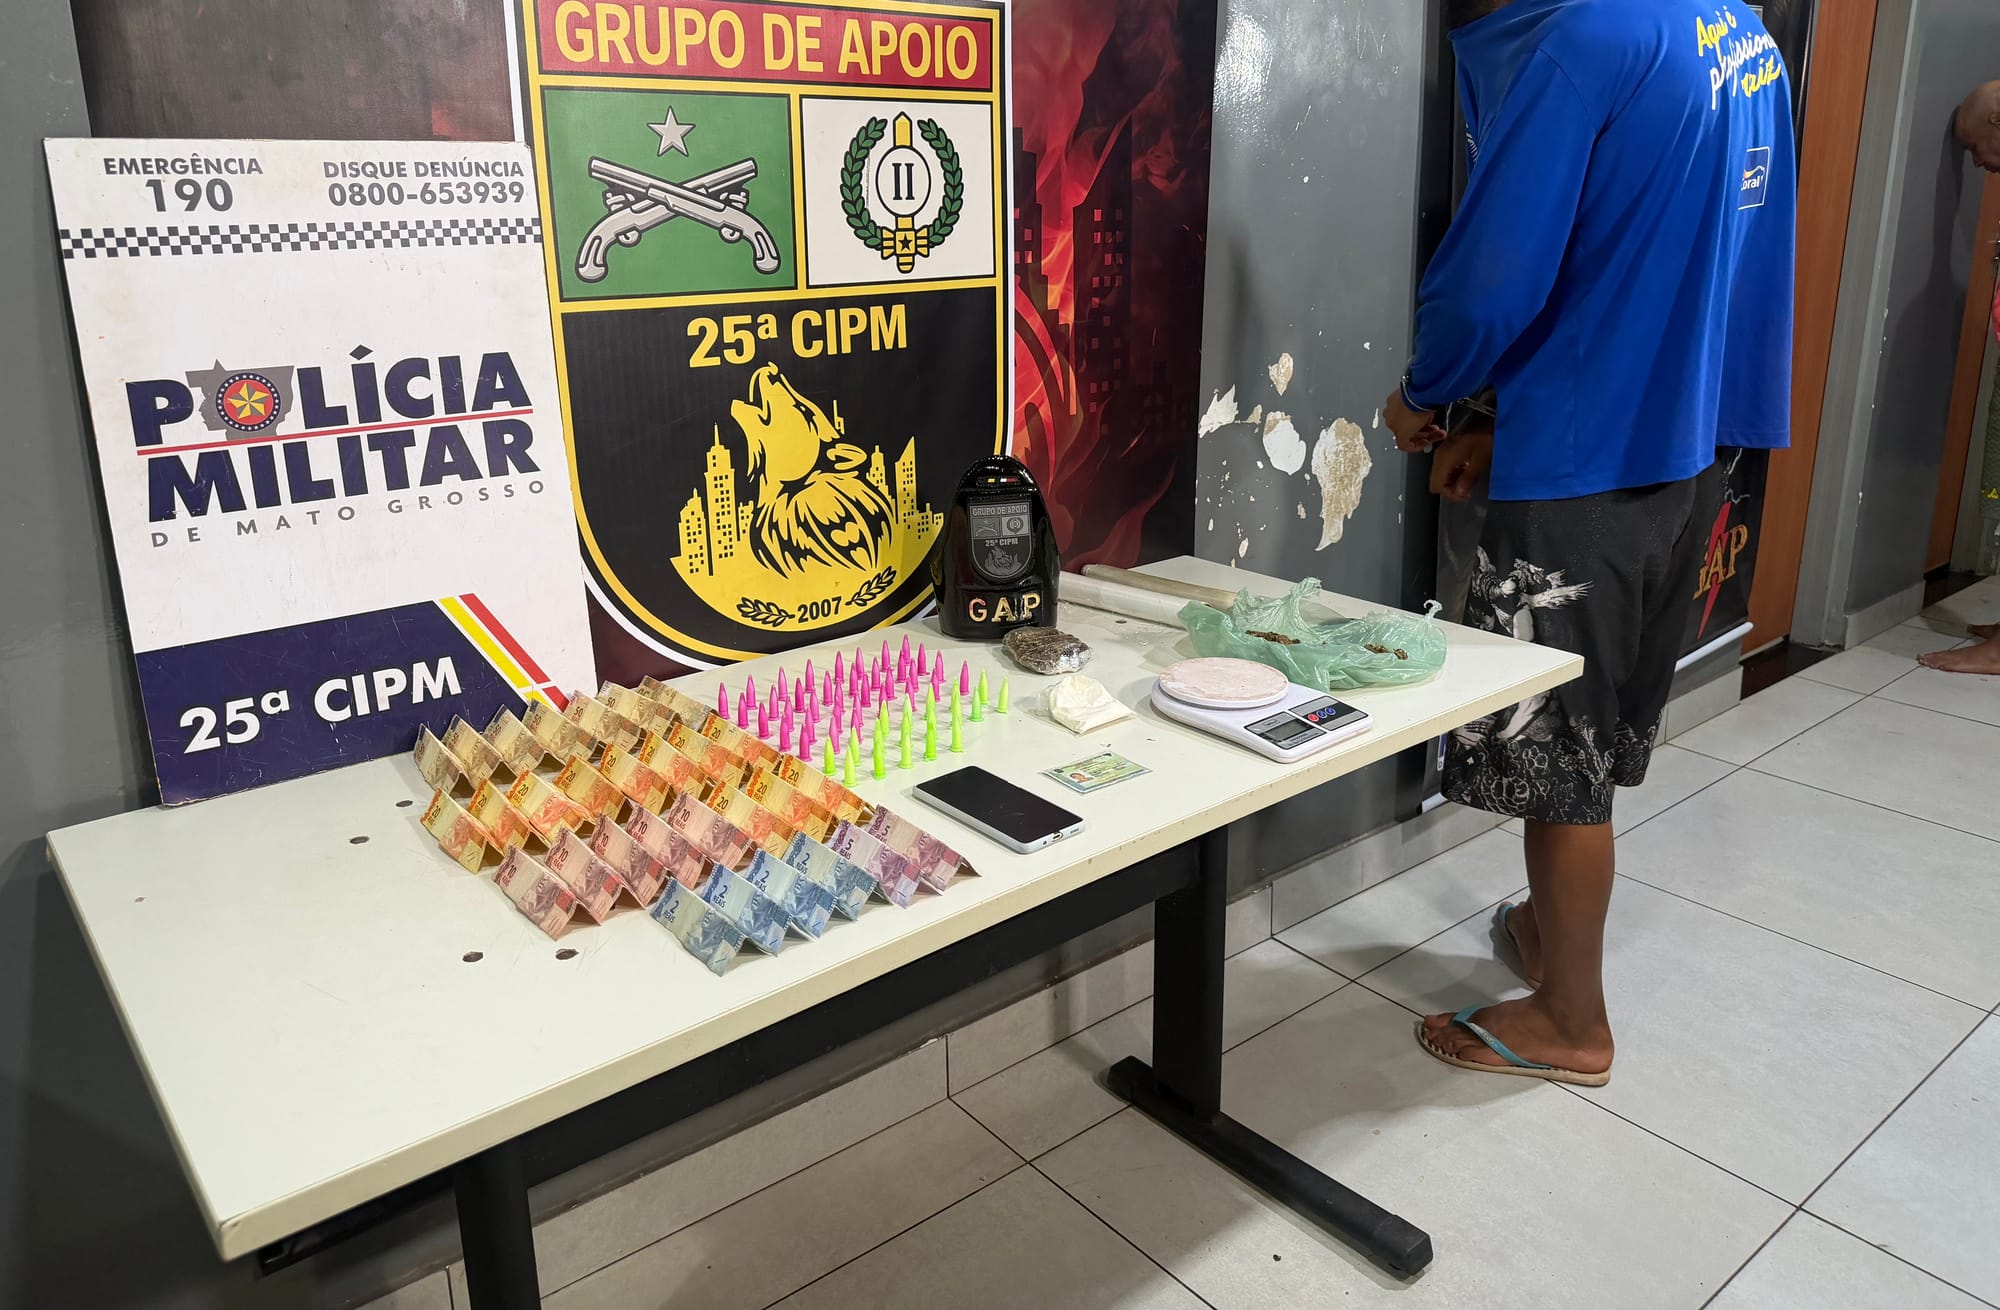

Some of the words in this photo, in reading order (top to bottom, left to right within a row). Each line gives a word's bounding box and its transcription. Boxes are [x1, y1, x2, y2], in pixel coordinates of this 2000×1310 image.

[554, 0, 746, 70] GRUPO
[762, 13, 825, 72] DE
[838, 18, 978, 80] APOIO
[103, 153, 263, 176] EMERGÊNCIA
[322, 160, 408, 180] DISQUE
[414, 157, 525, 179] DENÚNCIA
[145, 178, 234, 212] 190
[328, 181, 526, 207] 0800-653939
[791, 304, 908, 358] CIPM
[148, 419, 541, 523] MILITAR
[151, 525, 201, 548] DE
[236, 505, 355, 537] MATO
[387, 480, 545, 514] GROSSO
[972, 507, 996, 516] GRUPO
[997, 506, 1006, 515] DE
[1007, 504, 1028, 513] APOIO
[999, 537, 1019, 546] CIPM
[797, 597, 843, 624] 2007
[969, 592, 1042, 623] GAP
[313, 656, 463, 723] CIPM
[606, 697, 616, 708] 50
[573, 706, 583, 718] 50
[711, 727, 721, 739] 20
[674, 737, 686, 749] 20
[646, 746, 656, 758] 20
[606, 755, 617, 768] 20
[565, 770, 576, 783] 20
[787, 768, 800, 782] 20
[518, 784, 529, 796] 20
[756, 782, 768, 795] 20
[478, 794, 488, 808] 20
[716, 796, 729, 810] 20
[431, 806, 441, 818] 20
[680, 808, 691, 822] 10
[638, 821, 648, 835] 10
[880, 824, 891, 837] 5
[601, 833, 609, 847] 10
[845, 838, 854, 850] 5
[559, 848, 569, 862] 10
[800, 852, 810, 866] 2
[506, 864, 517, 878] 10
[760, 870, 770, 884] 2
[719, 884, 729, 899] 2
[669, 900, 680, 914] 2
